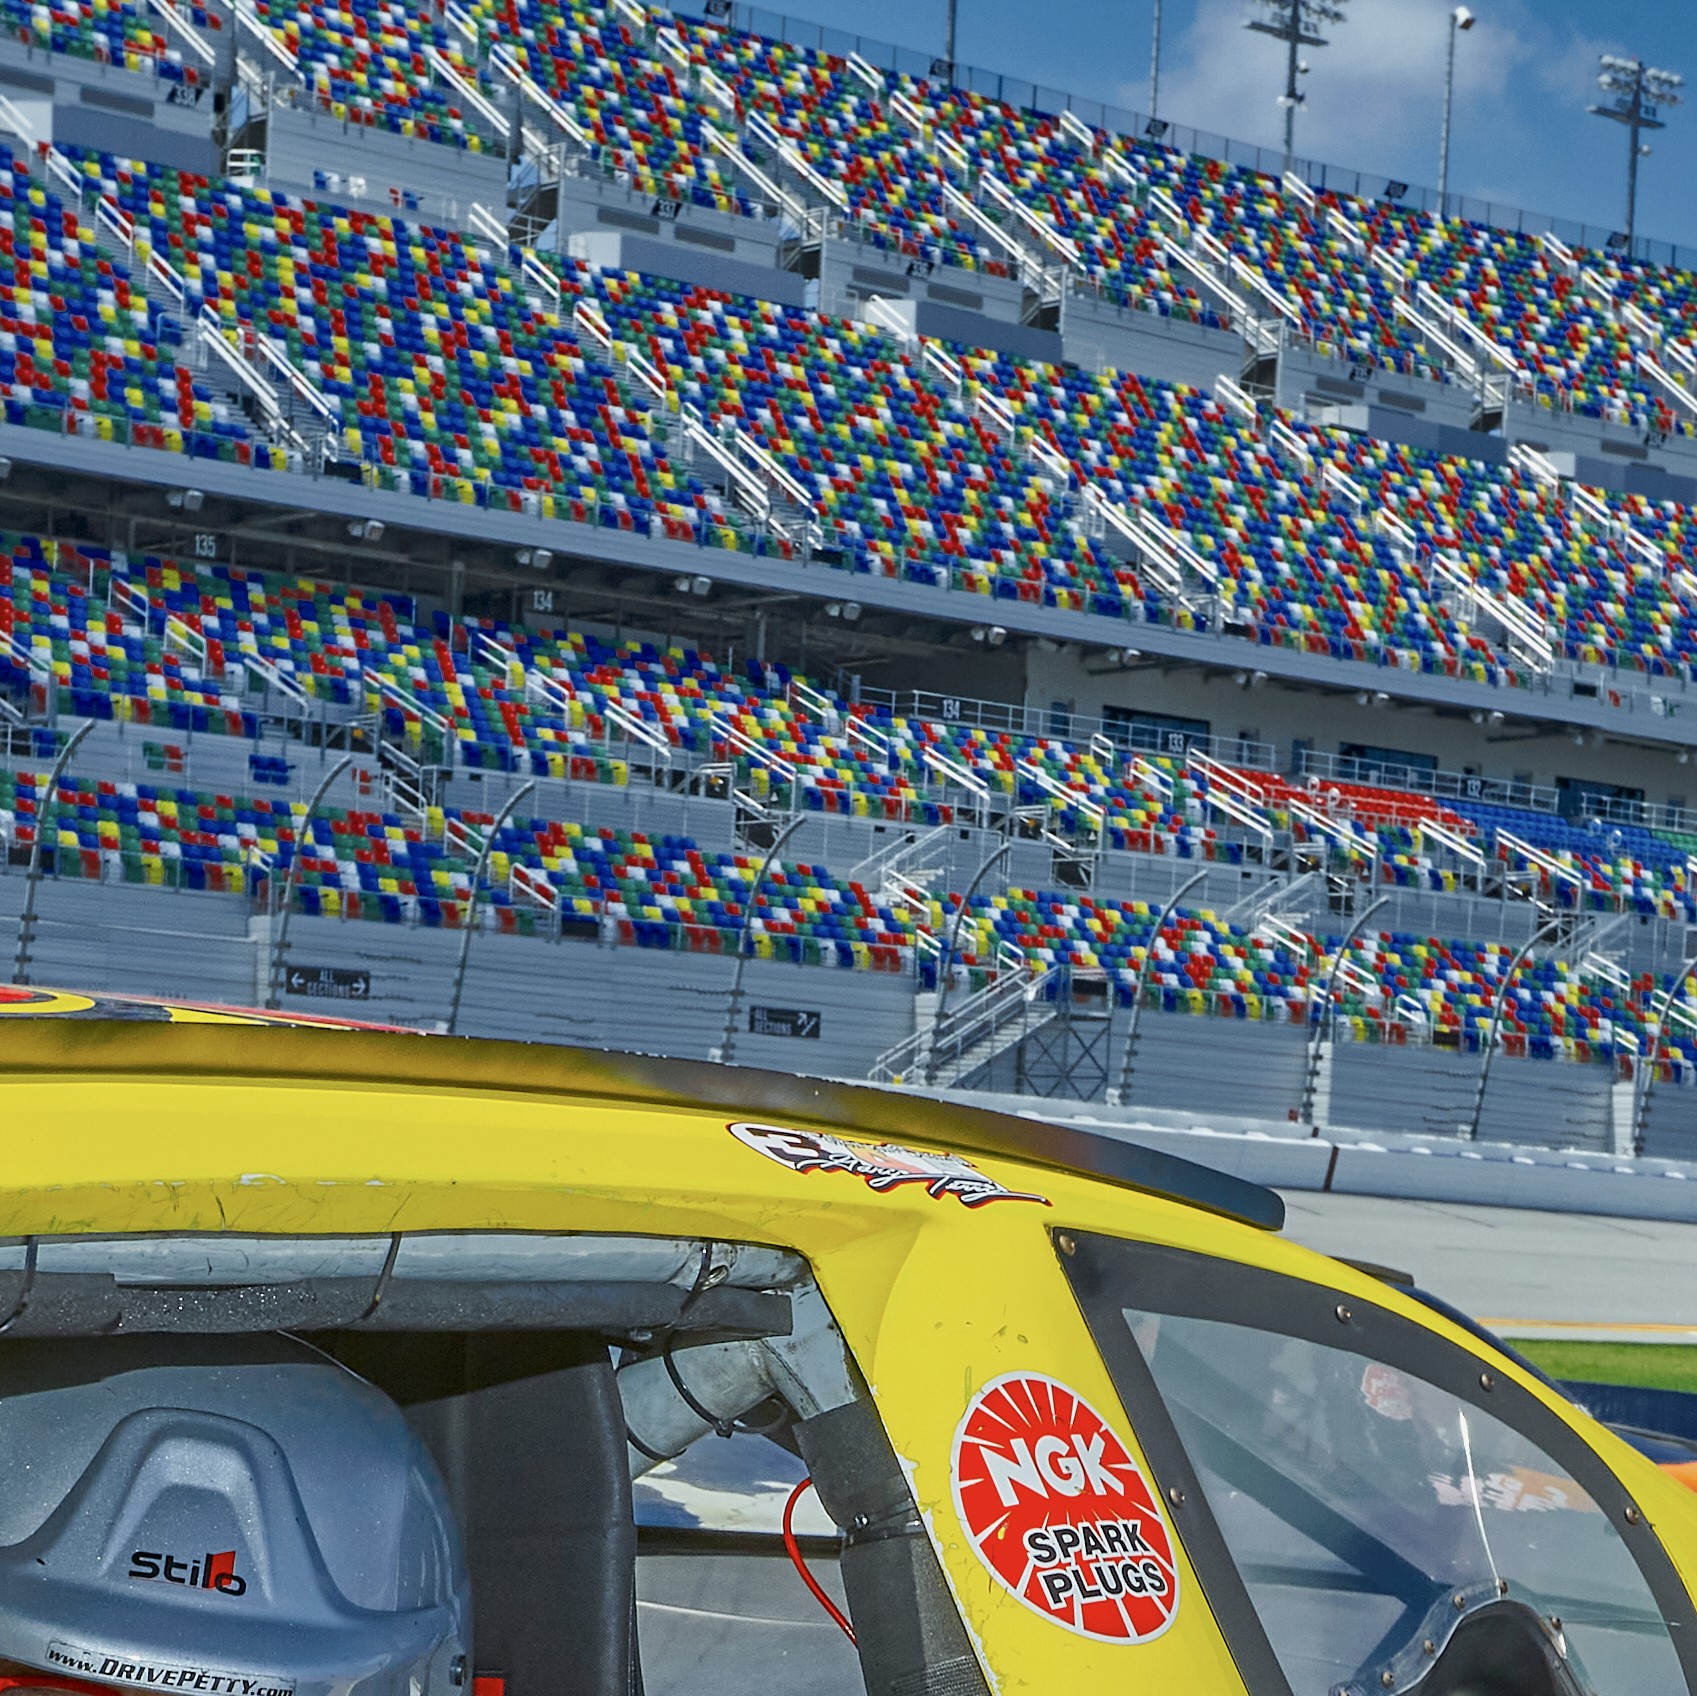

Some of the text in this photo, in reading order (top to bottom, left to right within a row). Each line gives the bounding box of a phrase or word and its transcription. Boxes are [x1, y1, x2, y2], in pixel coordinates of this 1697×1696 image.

[194, 534, 216, 558] 135
[533, 589, 553, 611] 134
[942, 699, 961, 720] 134
[978, 1433, 1125, 1508] NGK
[1031, 1519, 1151, 1567] SPARK
[1042, 1556, 1168, 1606] PLUGS
